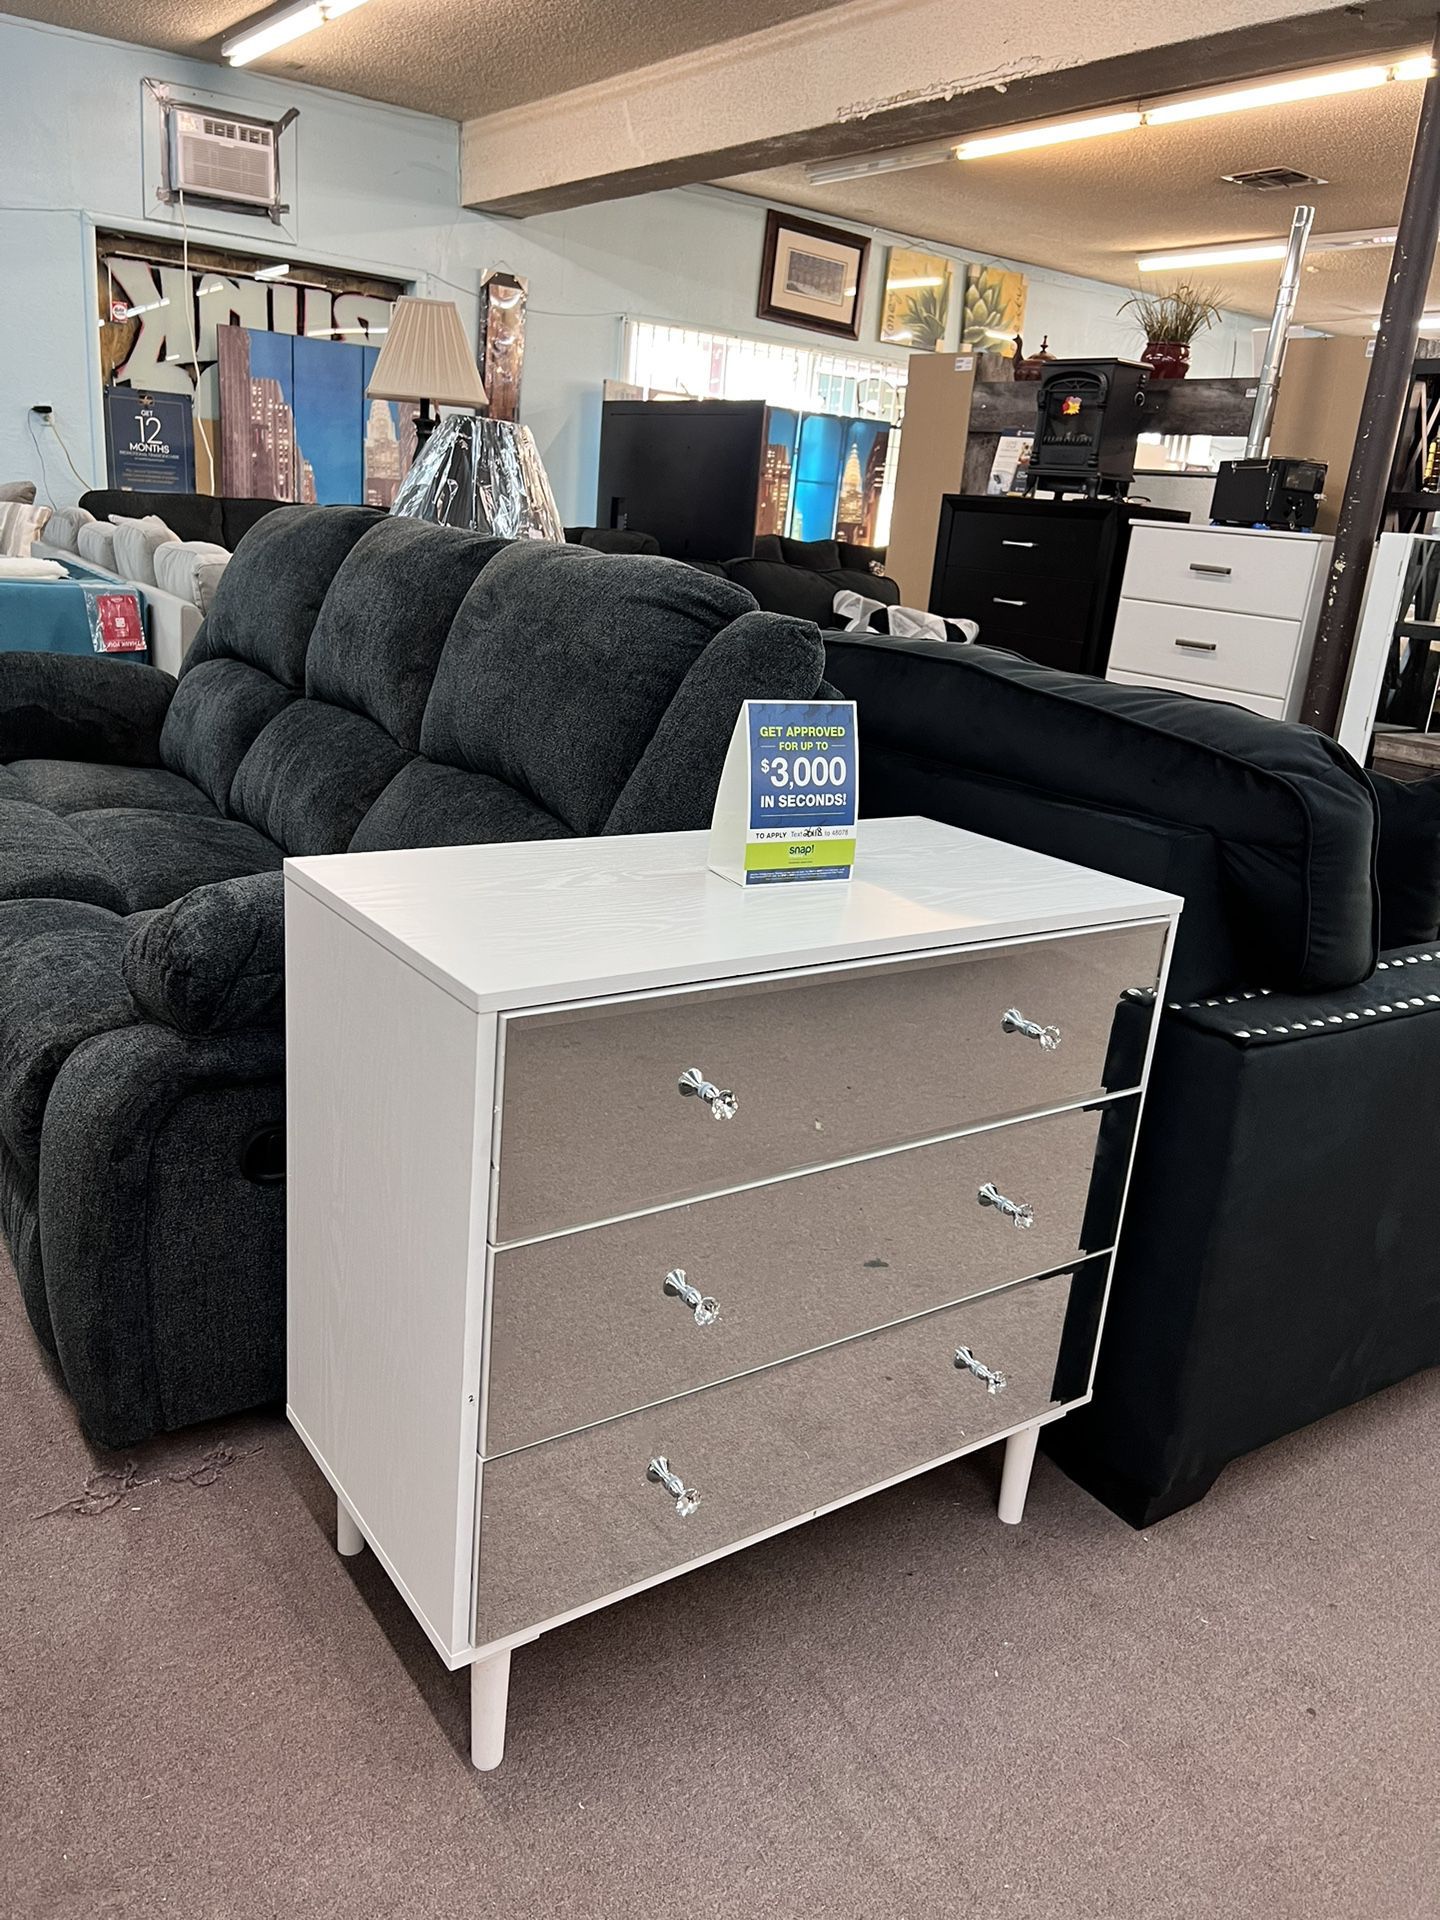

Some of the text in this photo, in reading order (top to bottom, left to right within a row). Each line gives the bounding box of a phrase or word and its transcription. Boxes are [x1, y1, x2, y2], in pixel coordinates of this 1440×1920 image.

[141, 409, 153, 417] GET
[135, 416, 163, 444] 12
[129, 442, 170, 454] MONTHS
[760, 726, 846, 737] GET APPROVED
[779, 741, 829, 751] FOR UP TO
[760, 756, 847, 790] $3,000
[760, 793, 847, 808] IN SECONDS!
[766, 831, 787, 839] APPLY
[789, 844, 815, 856] snap!
